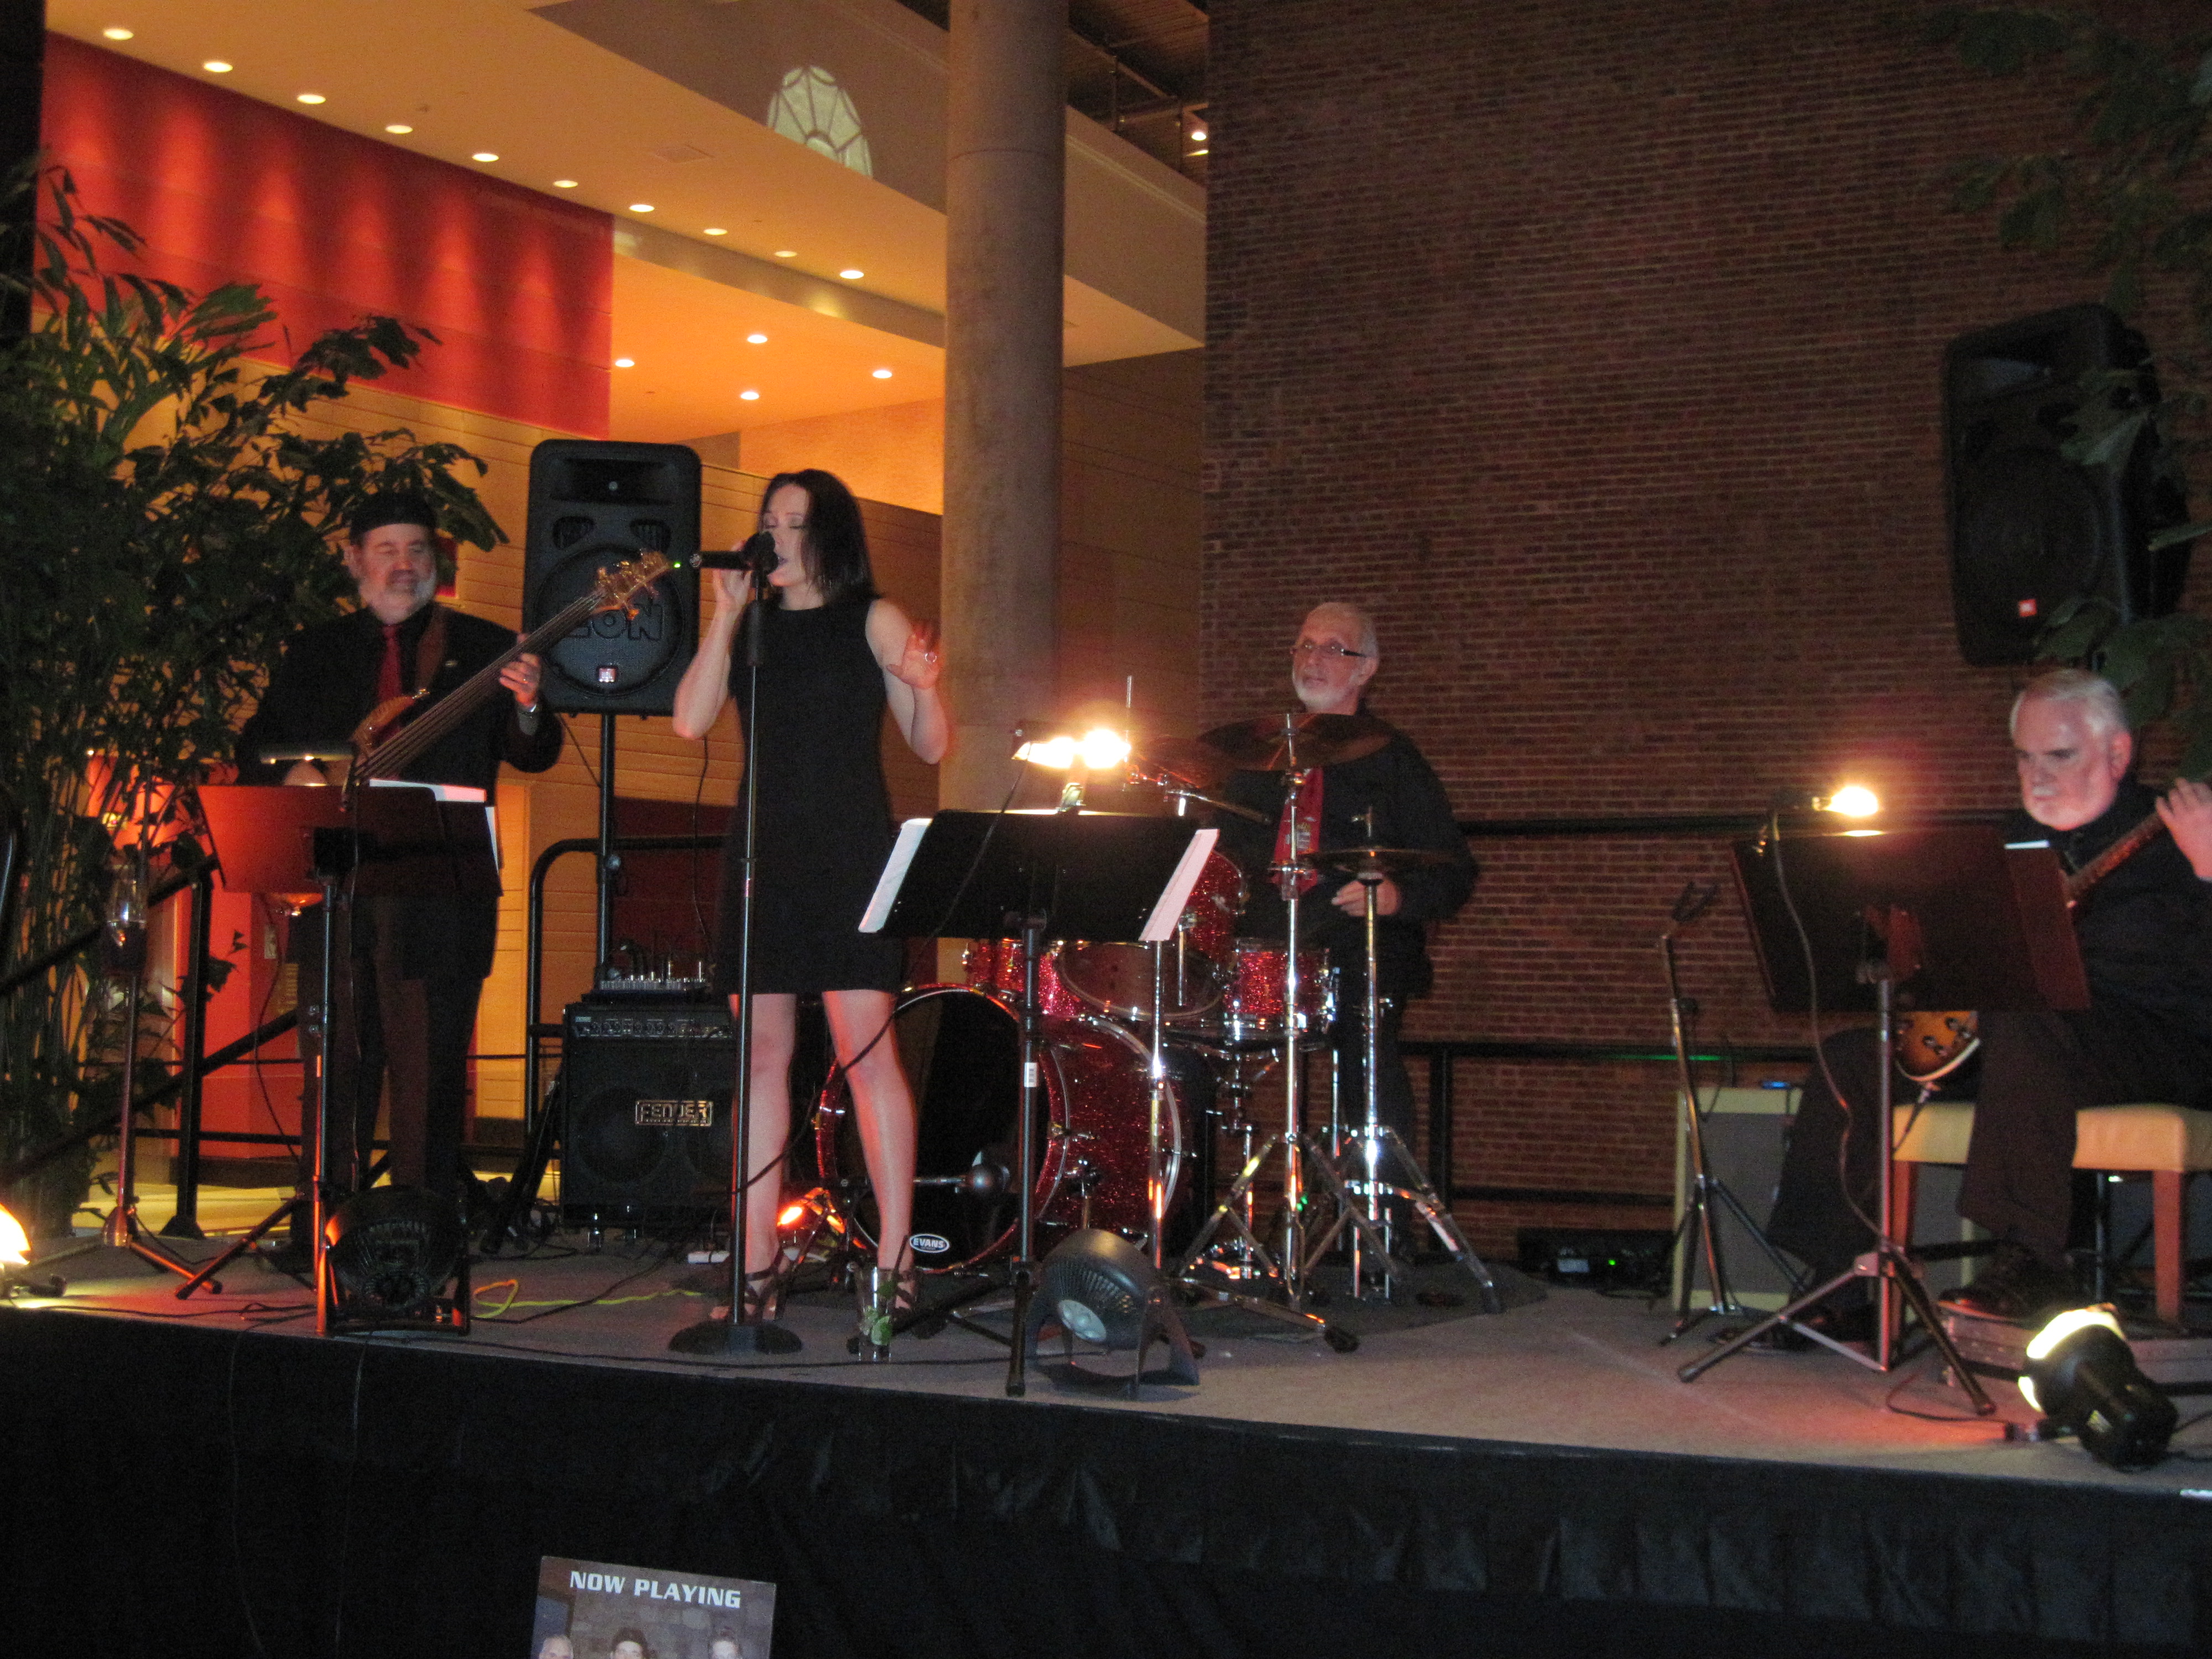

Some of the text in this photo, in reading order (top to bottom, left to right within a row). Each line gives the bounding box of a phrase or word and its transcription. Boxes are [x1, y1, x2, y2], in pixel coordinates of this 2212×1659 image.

[913, 1237, 945, 1249] EVANS
[570, 1570, 742, 1609] NOW PLAYING
